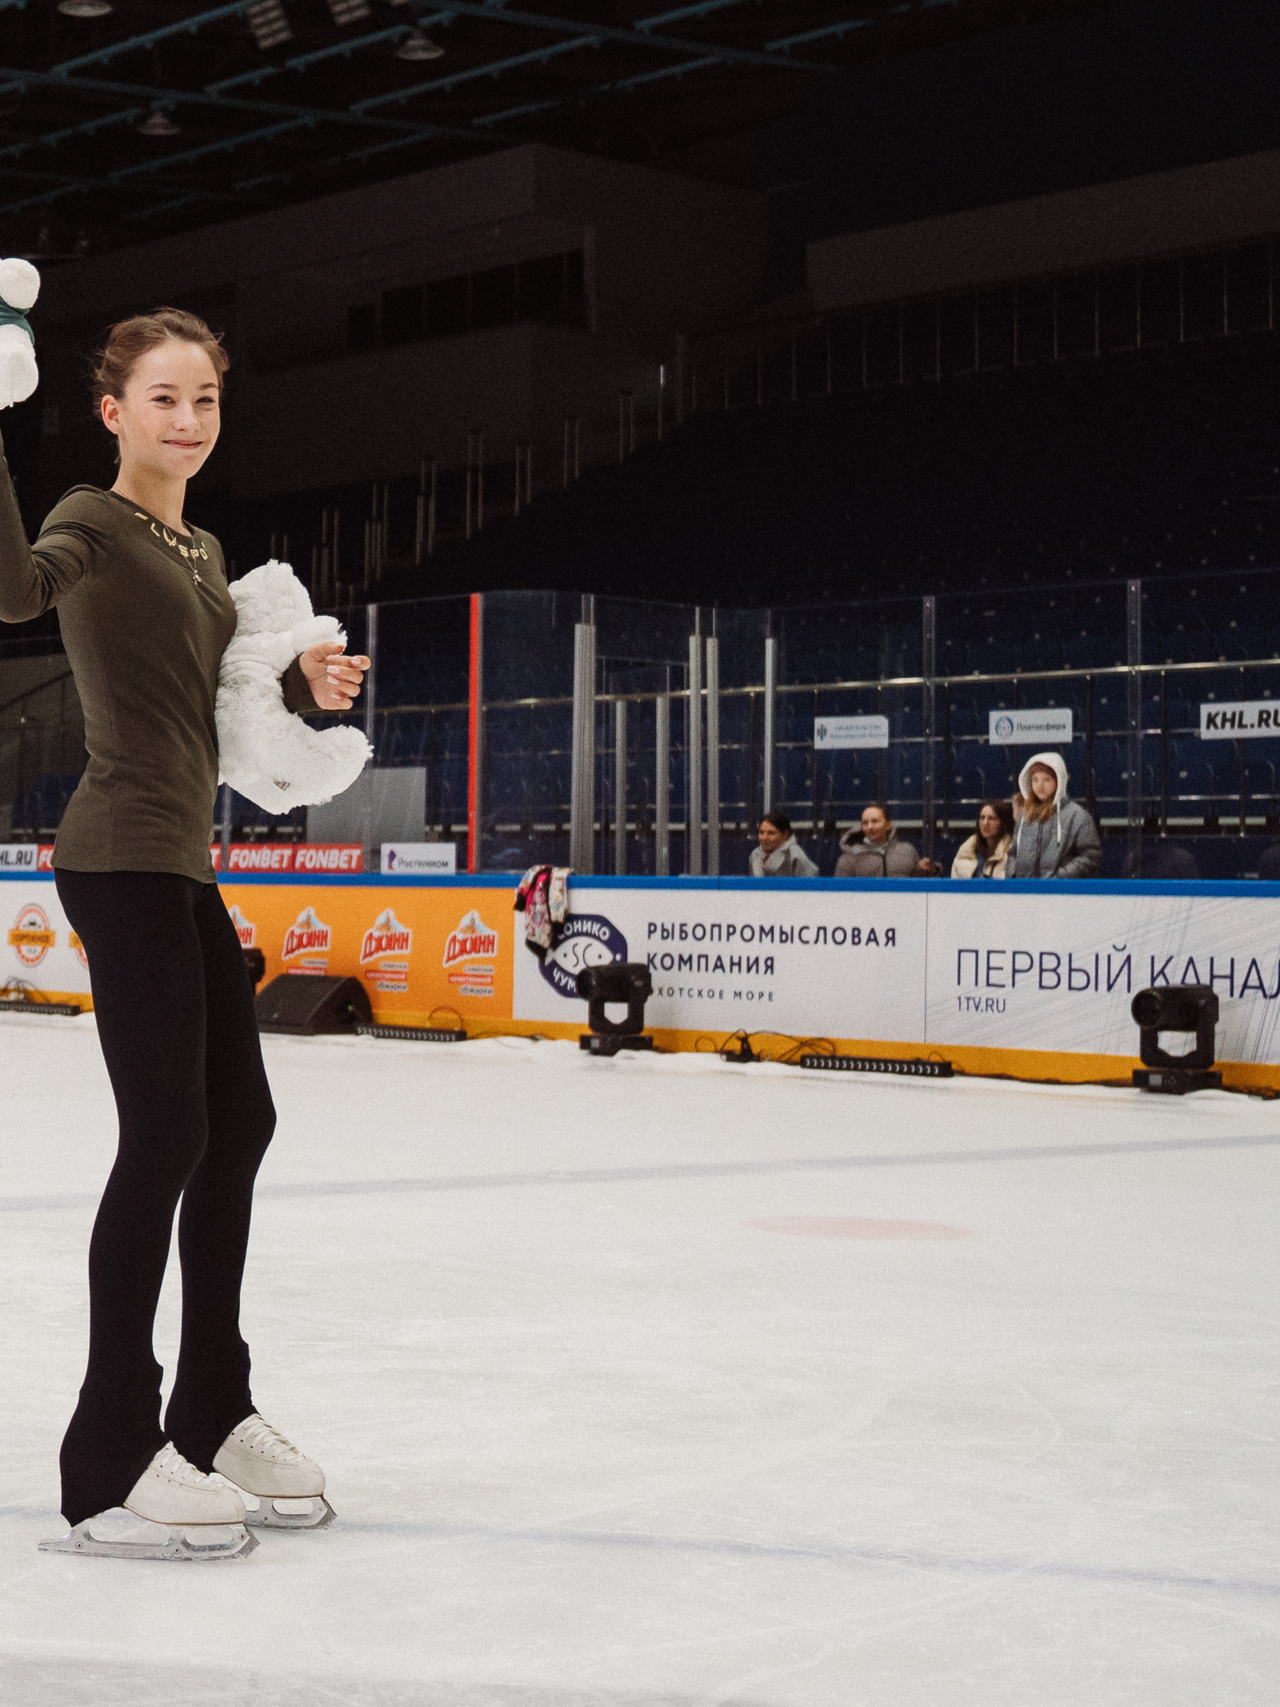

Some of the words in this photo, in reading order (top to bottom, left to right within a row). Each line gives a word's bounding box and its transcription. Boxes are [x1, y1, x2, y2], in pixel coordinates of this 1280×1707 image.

[229, 848, 292, 868] FONBET
[295, 848, 361, 869] FONBET
[398, 858, 449, 868] Ростелеком
[558, 920, 610, 941] ОНИКО
[648, 923, 896, 947] РЫБОПРОМЫСЛОВАЯ
[647, 953, 774, 975] КОМПАНИЯ
[957, 944, 1132, 993] ПЕРВЫЙ
[650, 987, 724, 1000] ХОТСКОЕ
[733, 991, 773, 1001] МОРЕ
[957, 995, 1006, 1013] 1TV.RU
